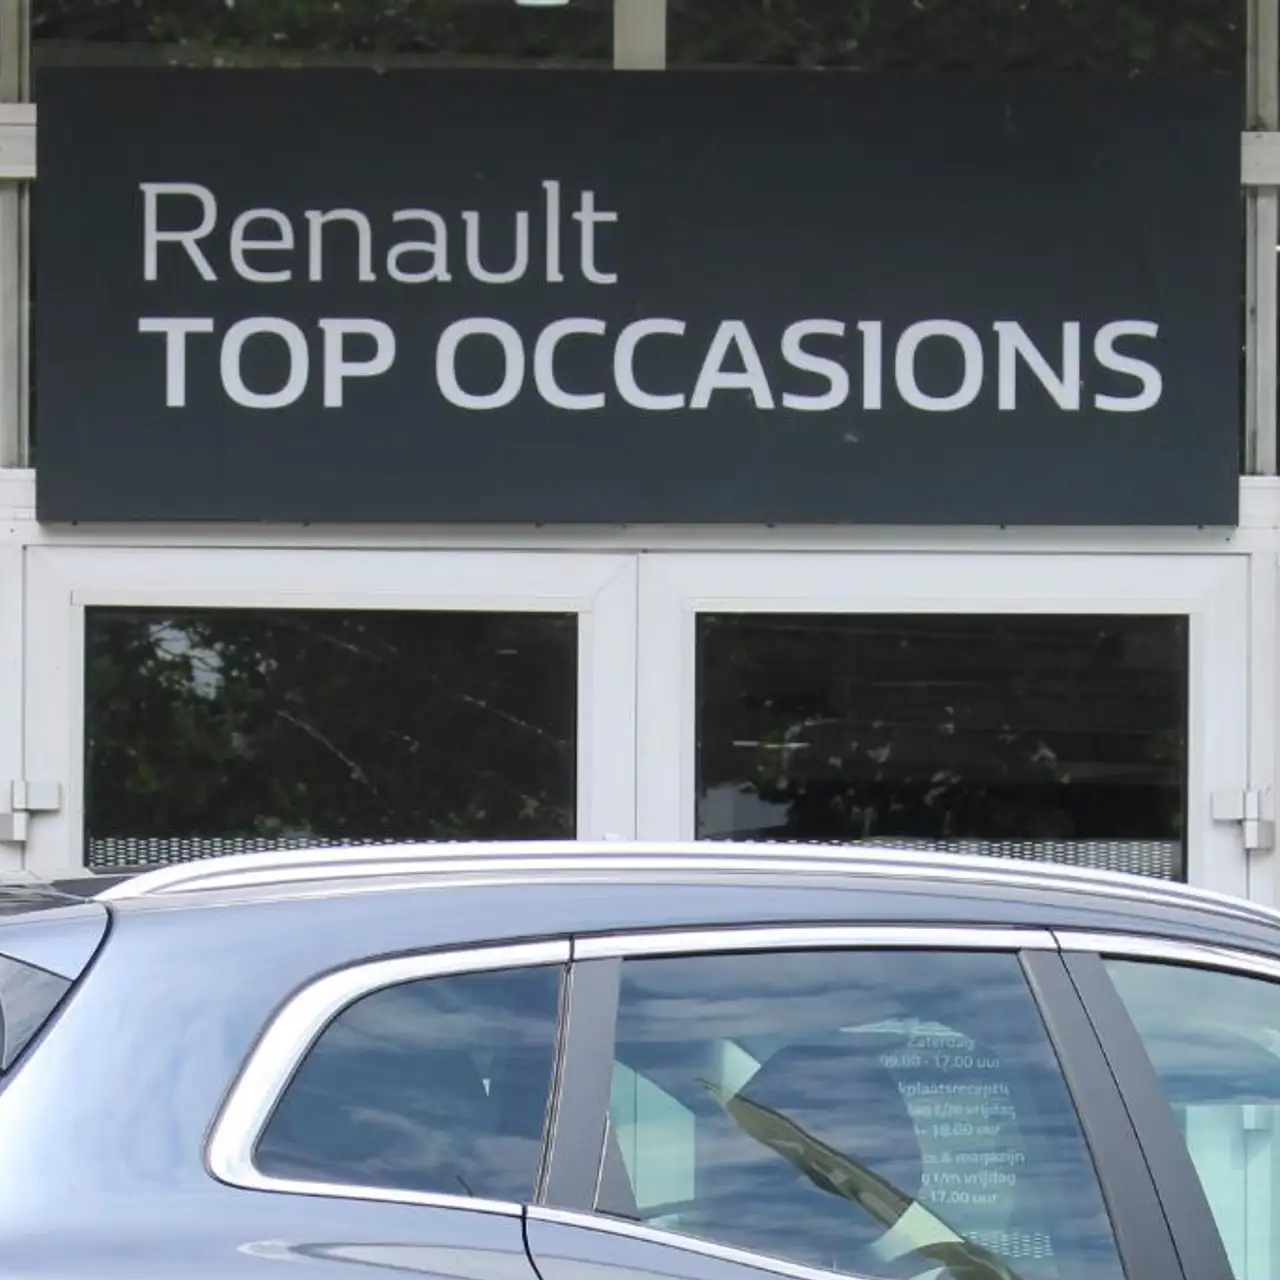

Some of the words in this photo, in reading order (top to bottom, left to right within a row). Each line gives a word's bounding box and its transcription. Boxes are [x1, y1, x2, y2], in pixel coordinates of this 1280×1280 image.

[138, 180, 618, 285] Renault
[138, 316, 396, 410] TOP
[434, 317, 1163, 413] OCCASIONS
[931, 1190, 969, 1204] 17.00
